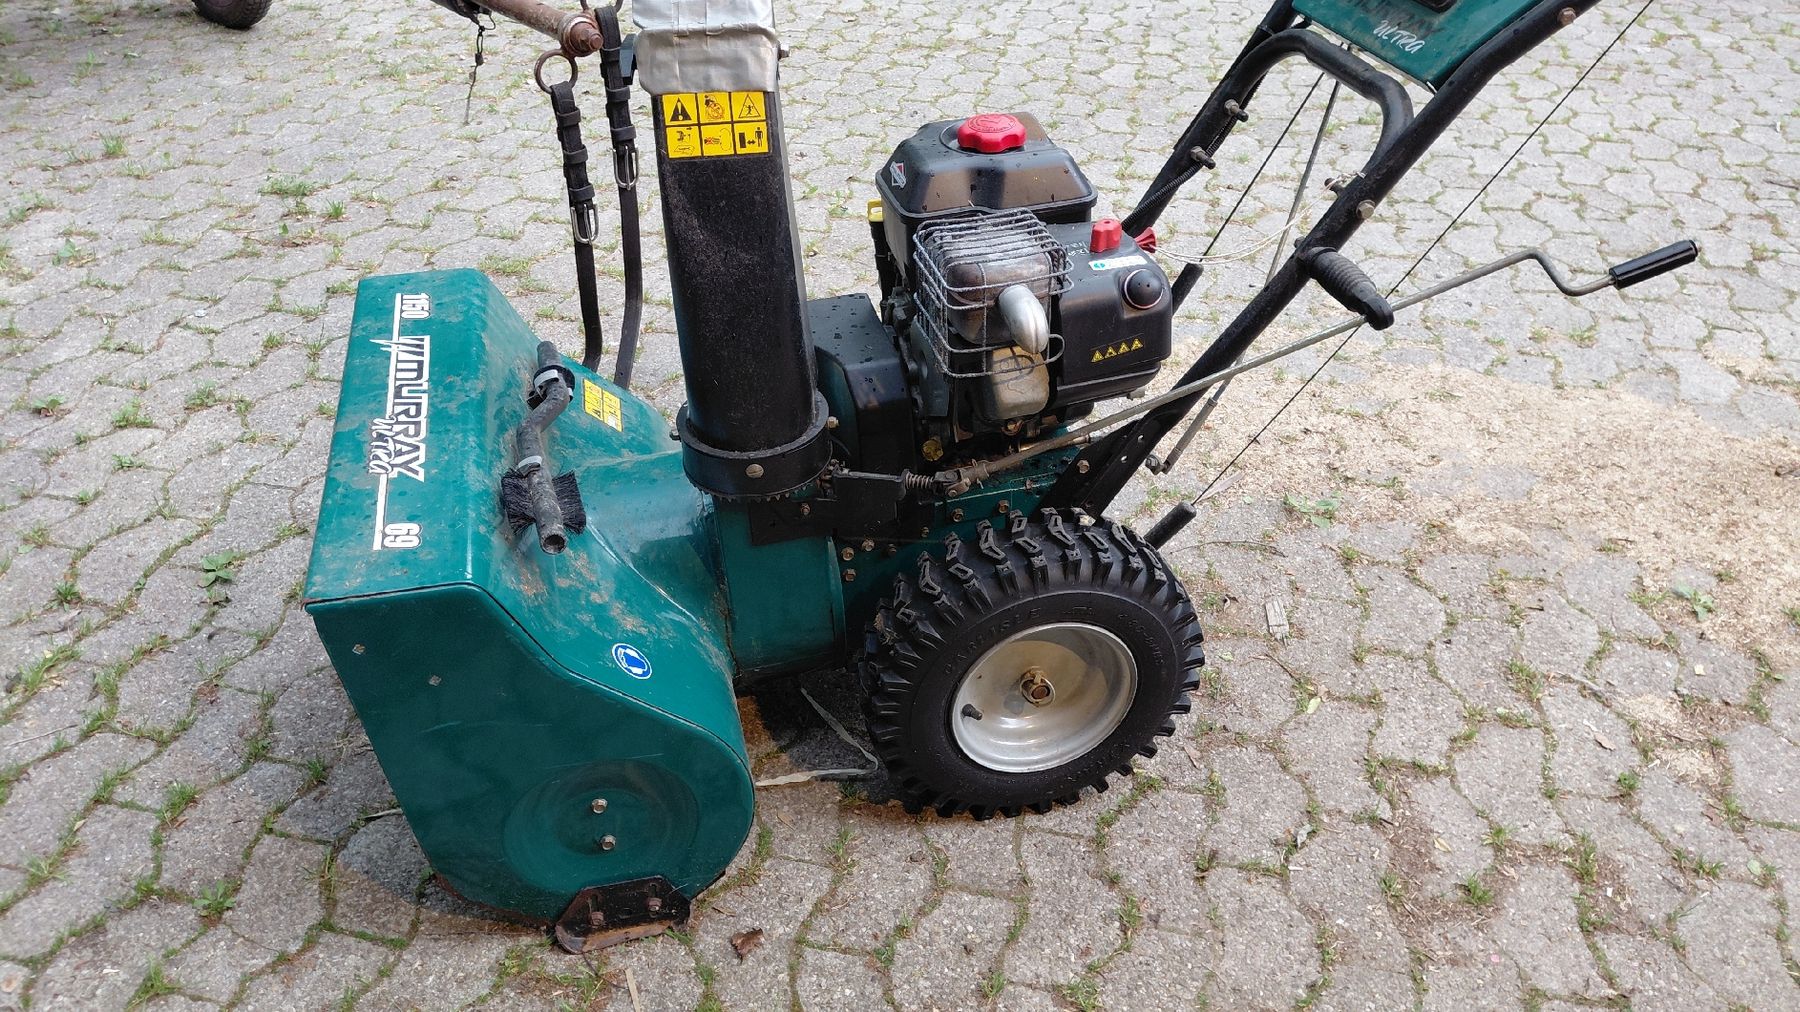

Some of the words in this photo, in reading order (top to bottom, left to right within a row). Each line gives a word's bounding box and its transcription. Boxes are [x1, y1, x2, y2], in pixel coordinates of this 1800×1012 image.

[1373, 20, 1425, 54] ULTRA
[387, 335, 430, 482] MURRAY
[383, 522, 423, 549] 69
